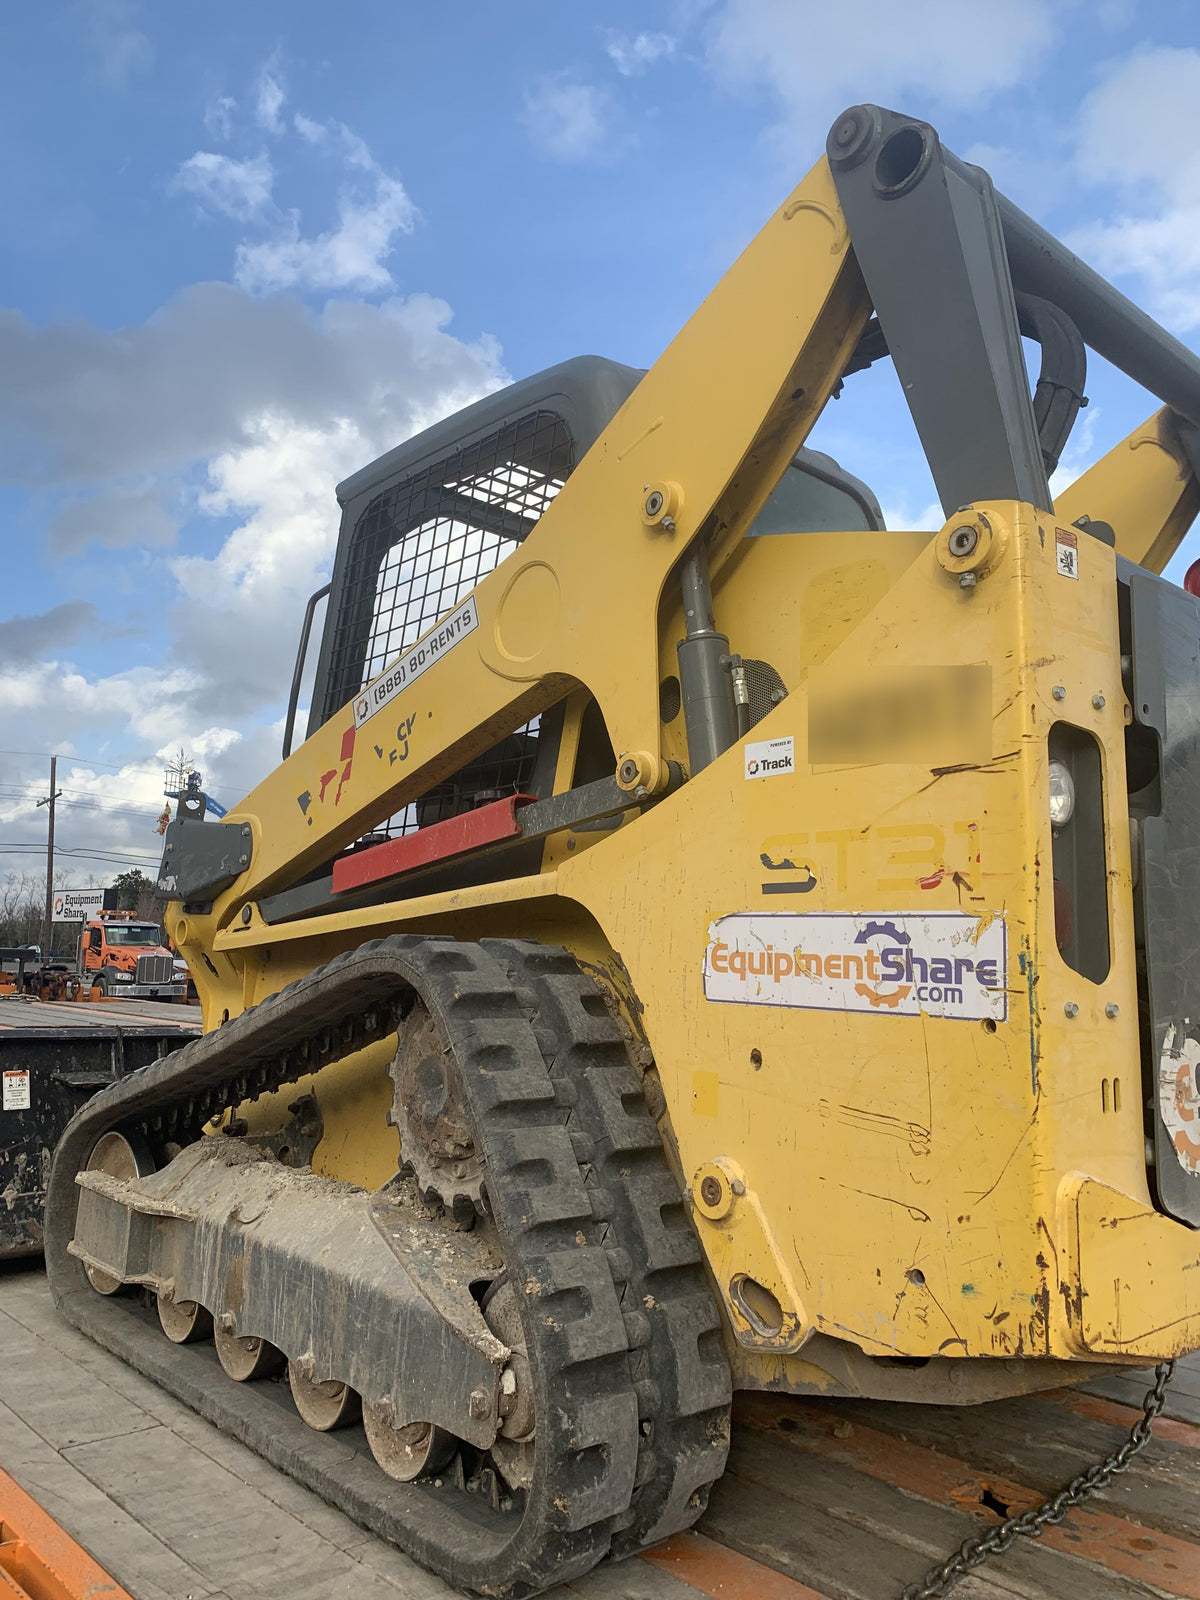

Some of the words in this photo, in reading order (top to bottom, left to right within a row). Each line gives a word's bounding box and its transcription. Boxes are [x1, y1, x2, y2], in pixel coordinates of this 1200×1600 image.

[374, 665, 407, 705] (888)
[410, 609, 472, 673] 80-RENTS
[760, 755, 792, 771] Track
[65, 894, 102, 906] Equipment
[63, 907, 84, 918] Share
[911, 986, 963, 1004] .com
